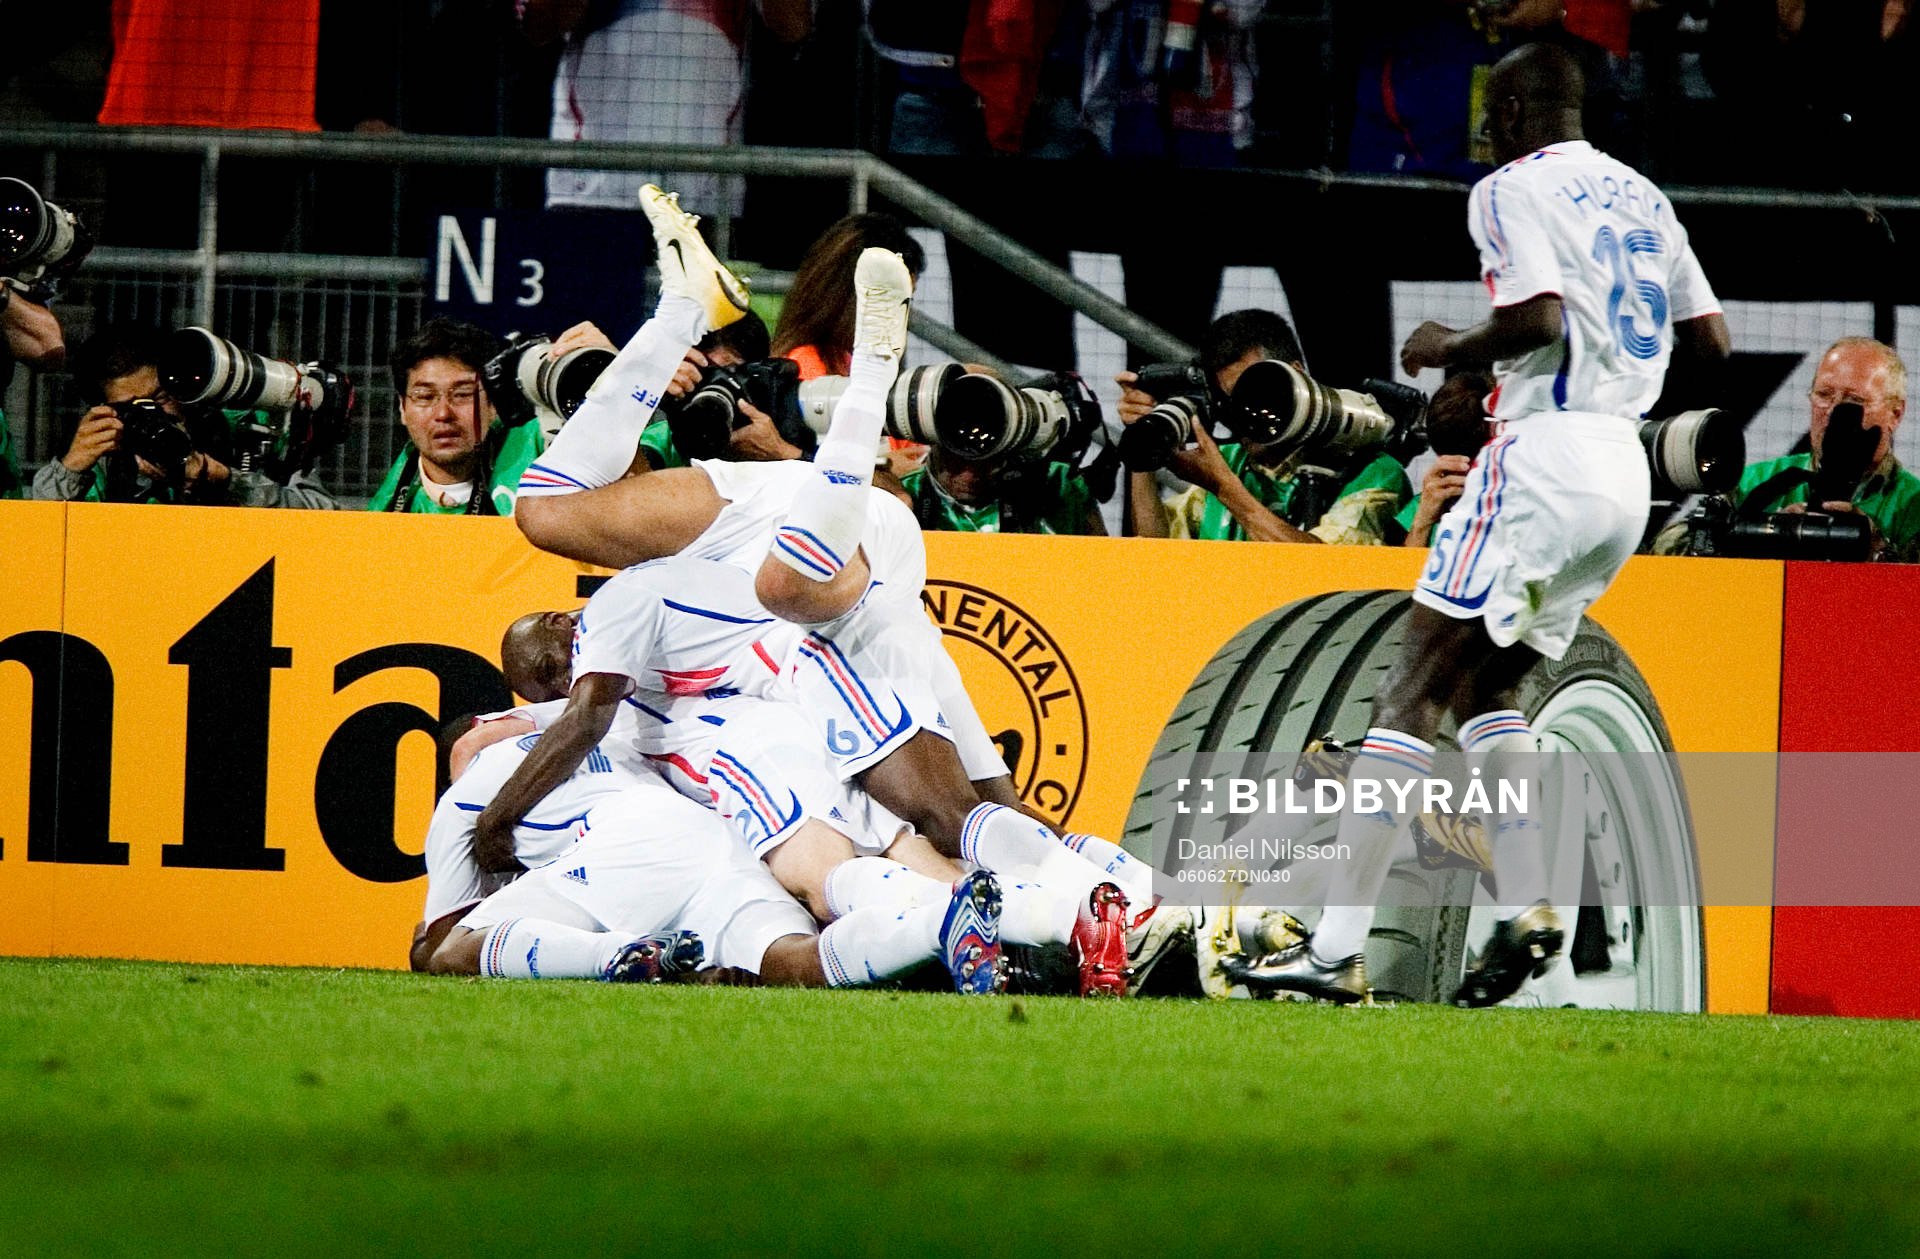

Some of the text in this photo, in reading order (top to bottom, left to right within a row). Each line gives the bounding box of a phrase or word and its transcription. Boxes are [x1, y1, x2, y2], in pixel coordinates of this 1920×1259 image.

[435, 215, 545, 307] N 3
[1592, 224, 1668, 360] 15
[0, 555, 614, 883] nta
[827, 718, 861, 756] 6
